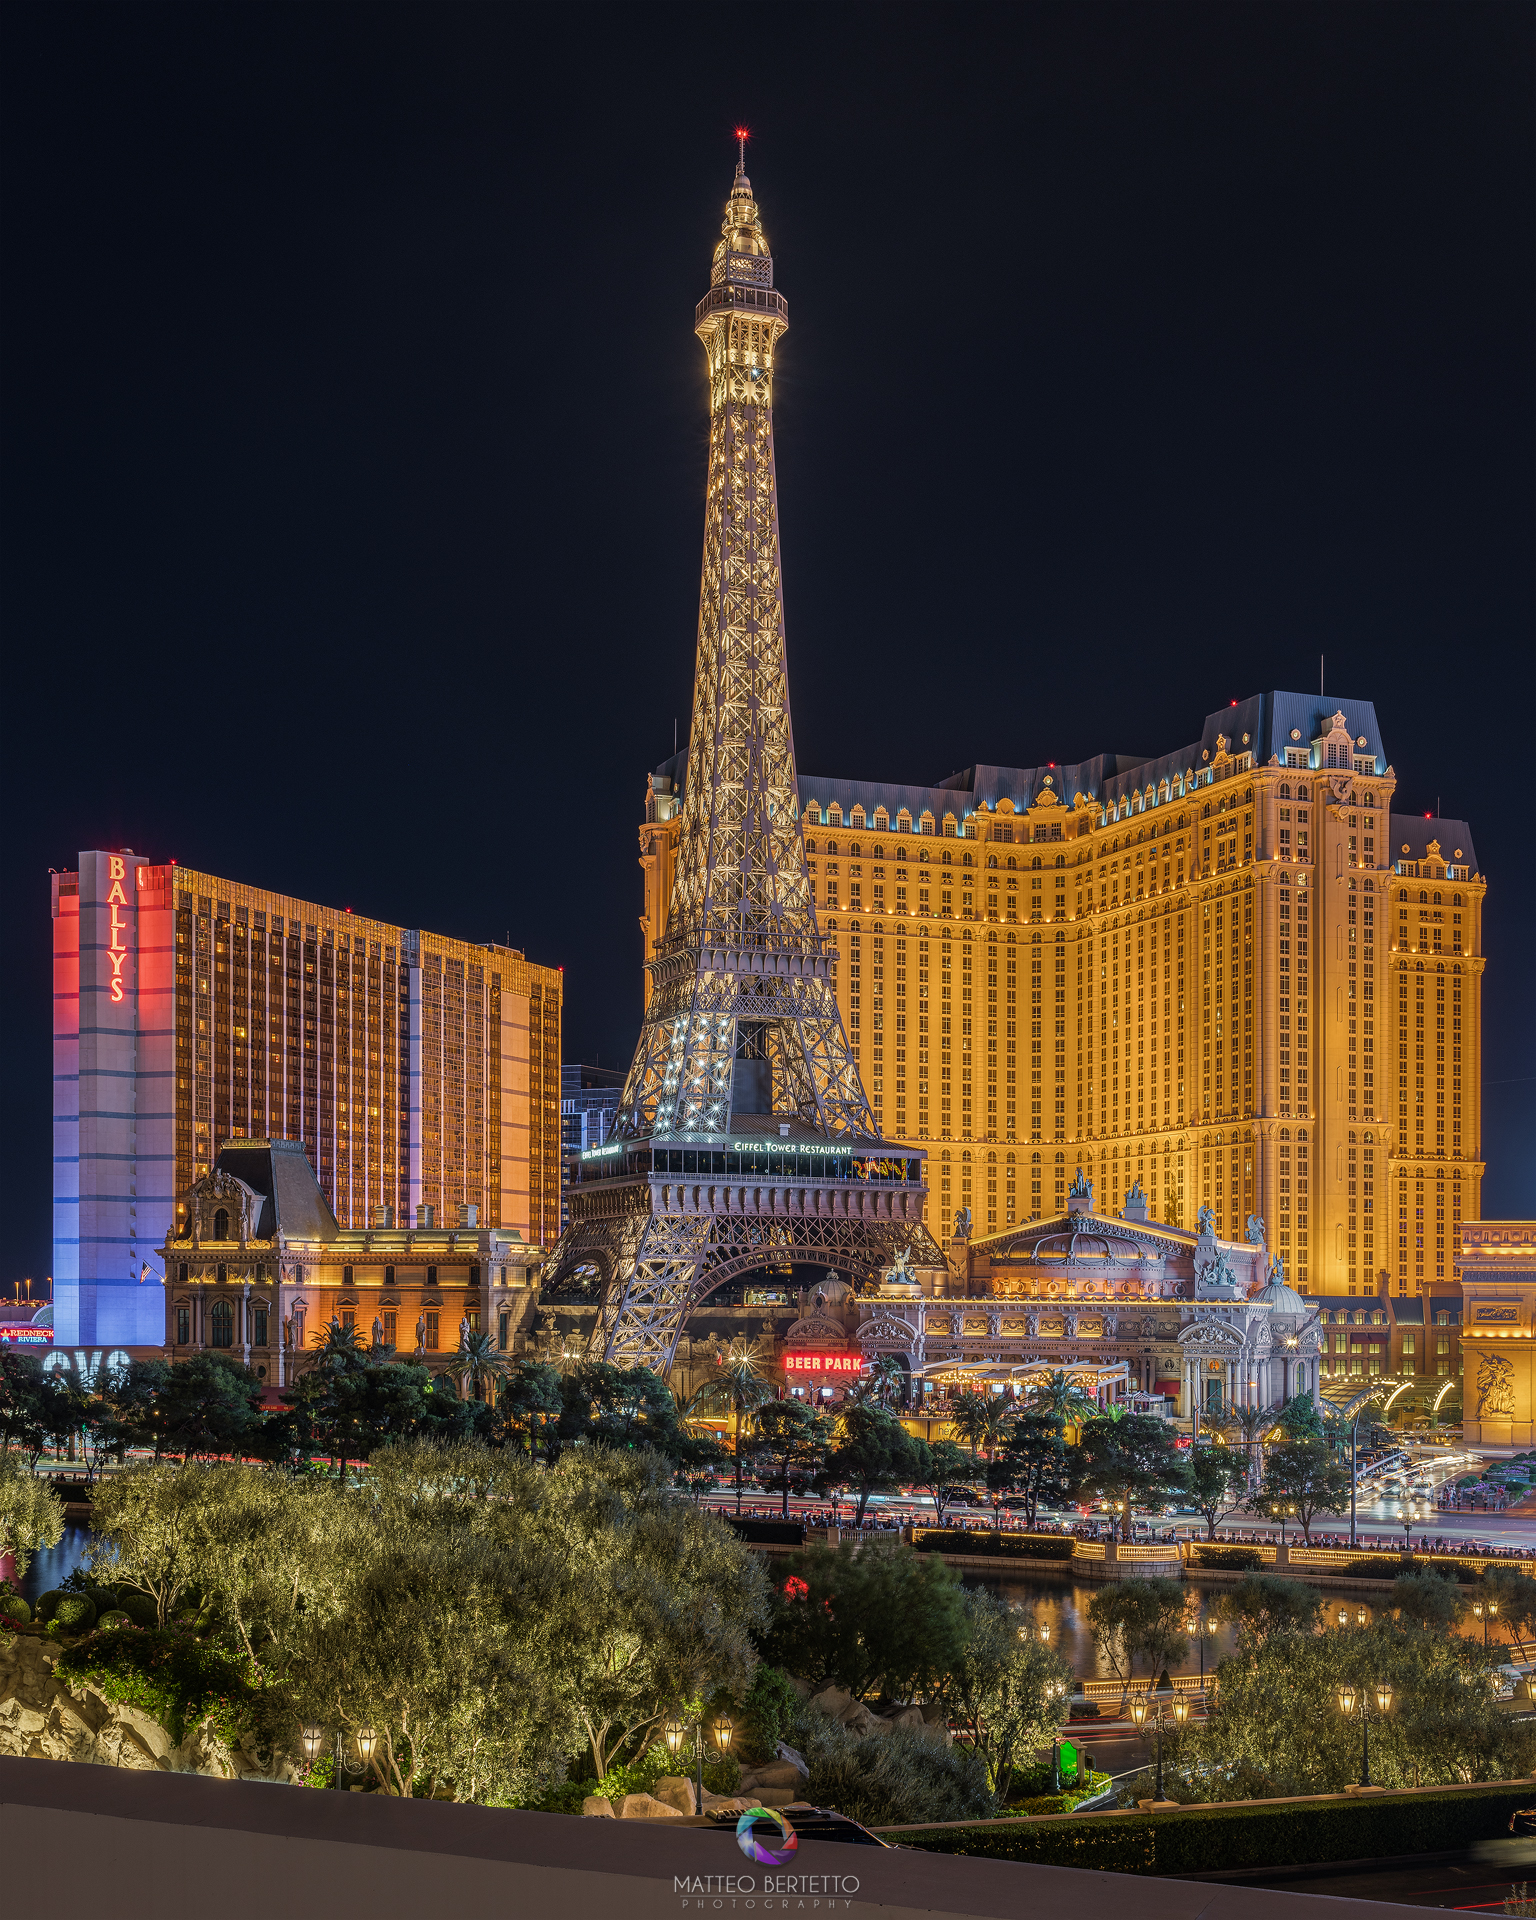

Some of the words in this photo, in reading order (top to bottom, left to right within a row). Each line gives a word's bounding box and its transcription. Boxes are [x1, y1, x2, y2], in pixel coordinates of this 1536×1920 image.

[107, 856, 127, 1002] BALLYS
[734, 1142, 764, 1152] EIFFEL
[765, 1142, 797, 1153] TOWER
[800, 1144, 852, 1155] RESTAURANT
[10, 1329, 54, 1337] REDNECK
[786, 1357, 821, 1369] BEER
[825, 1357, 862, 1370] PARK
